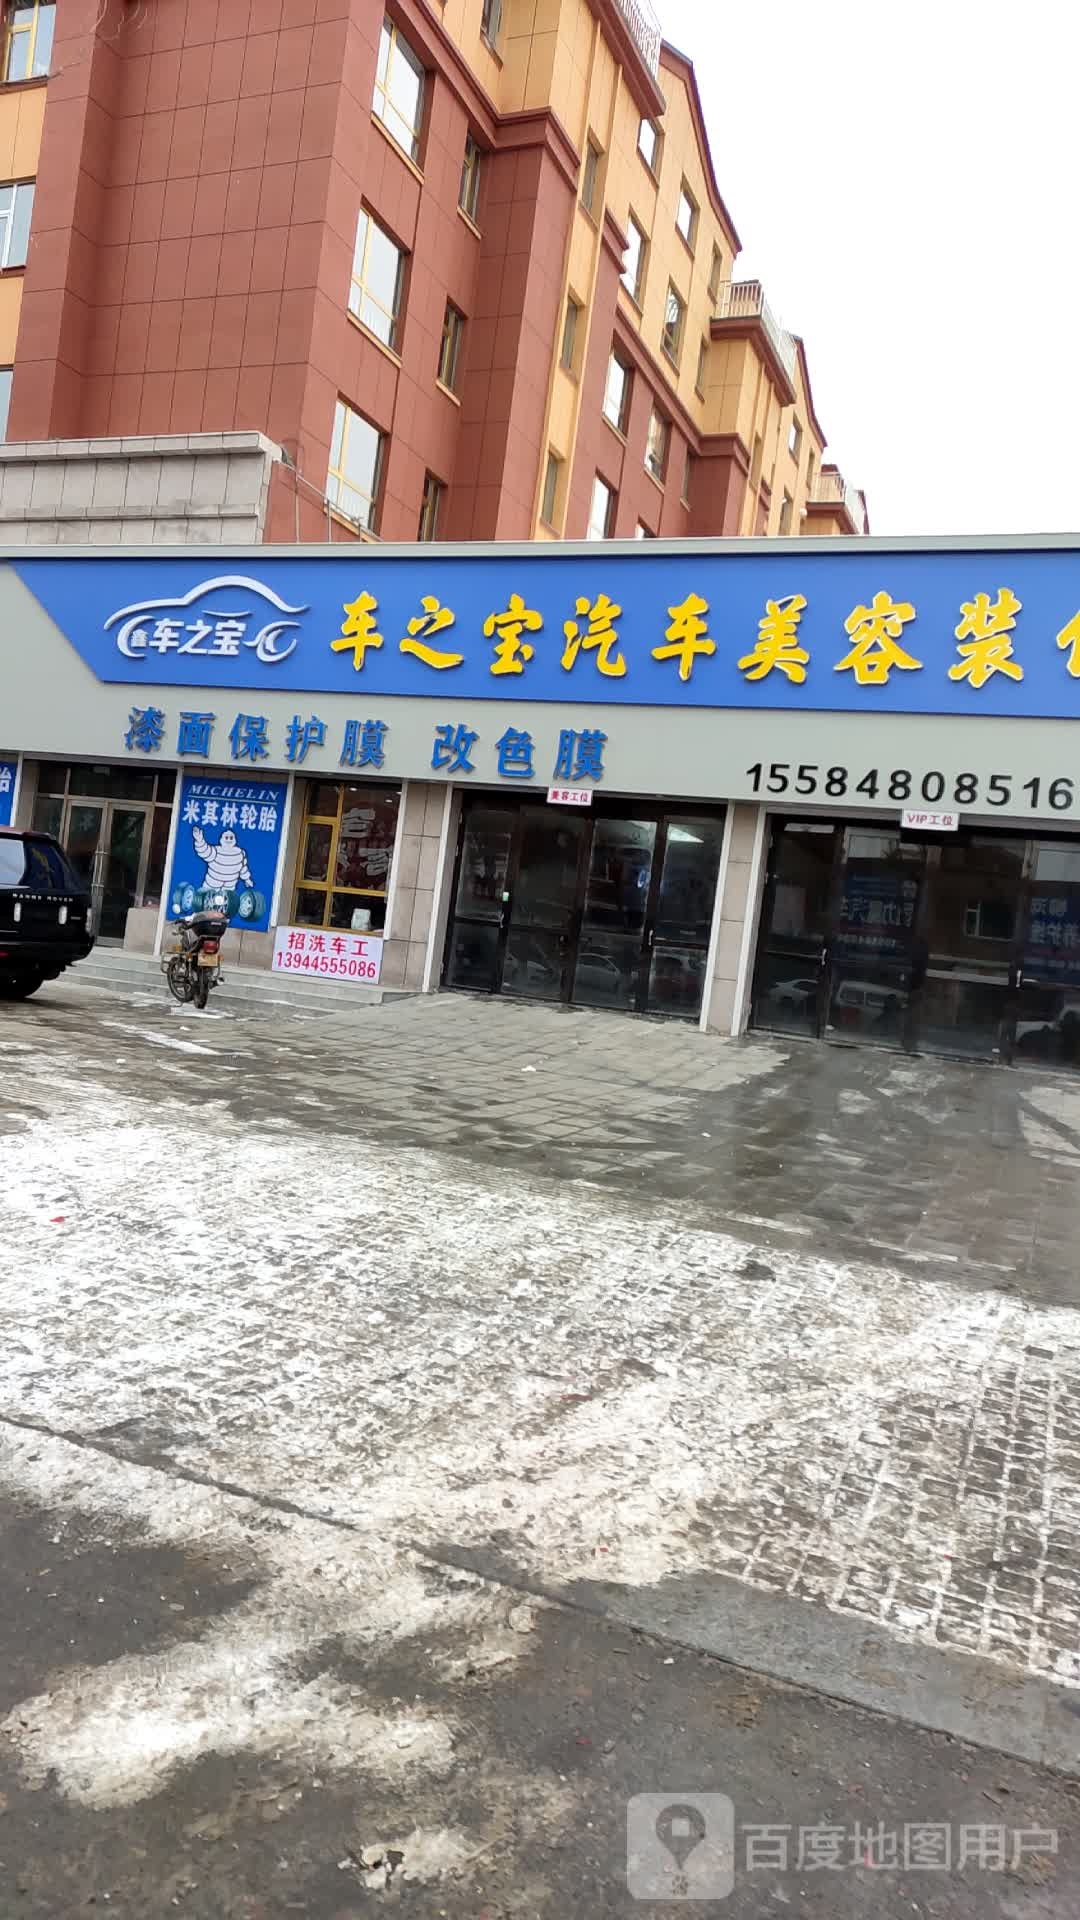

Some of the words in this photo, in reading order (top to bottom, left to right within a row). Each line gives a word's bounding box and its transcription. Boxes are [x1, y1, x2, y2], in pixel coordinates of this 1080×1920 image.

[124, 706, 388, 769] 漆面保护膜
[431, 724, 608, 782] 改色膜
[188, 784, 279, 801] MICHELIN
[746, 762, 1075, 810] 15584808516
[182, 799, 278, 832] 米其林轮胎
[288, 932, 369, 957] 招洗车工
[277, 951, 377, 979] 13944555086
